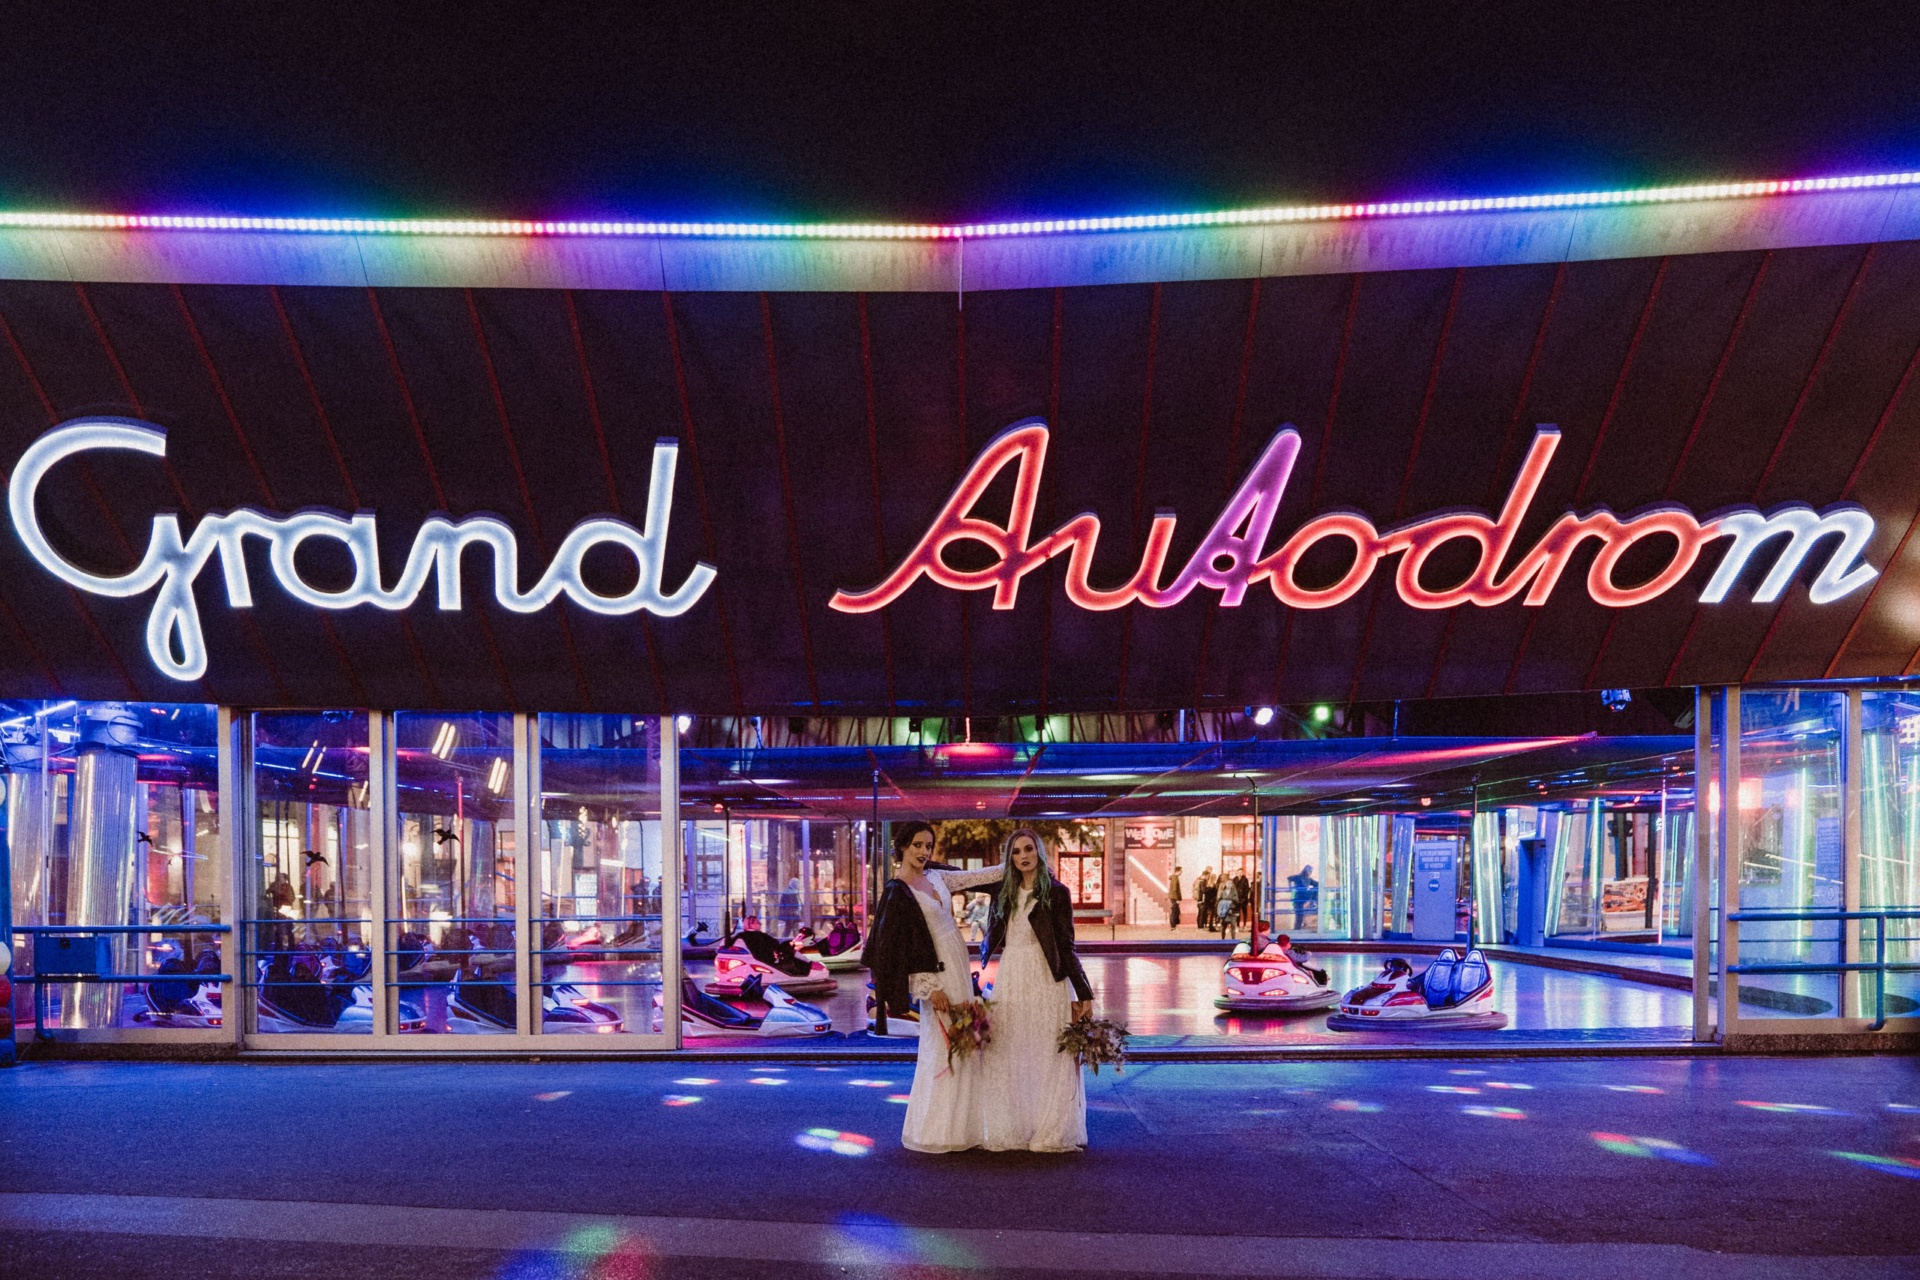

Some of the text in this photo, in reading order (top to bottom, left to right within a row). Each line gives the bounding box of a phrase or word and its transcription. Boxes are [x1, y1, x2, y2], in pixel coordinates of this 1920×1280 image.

[8, 417, 1879, 682] Grand Autodrom
[1125, 828, 1175, 841] WELOME
[1247, 971, 1254, 982] 1
